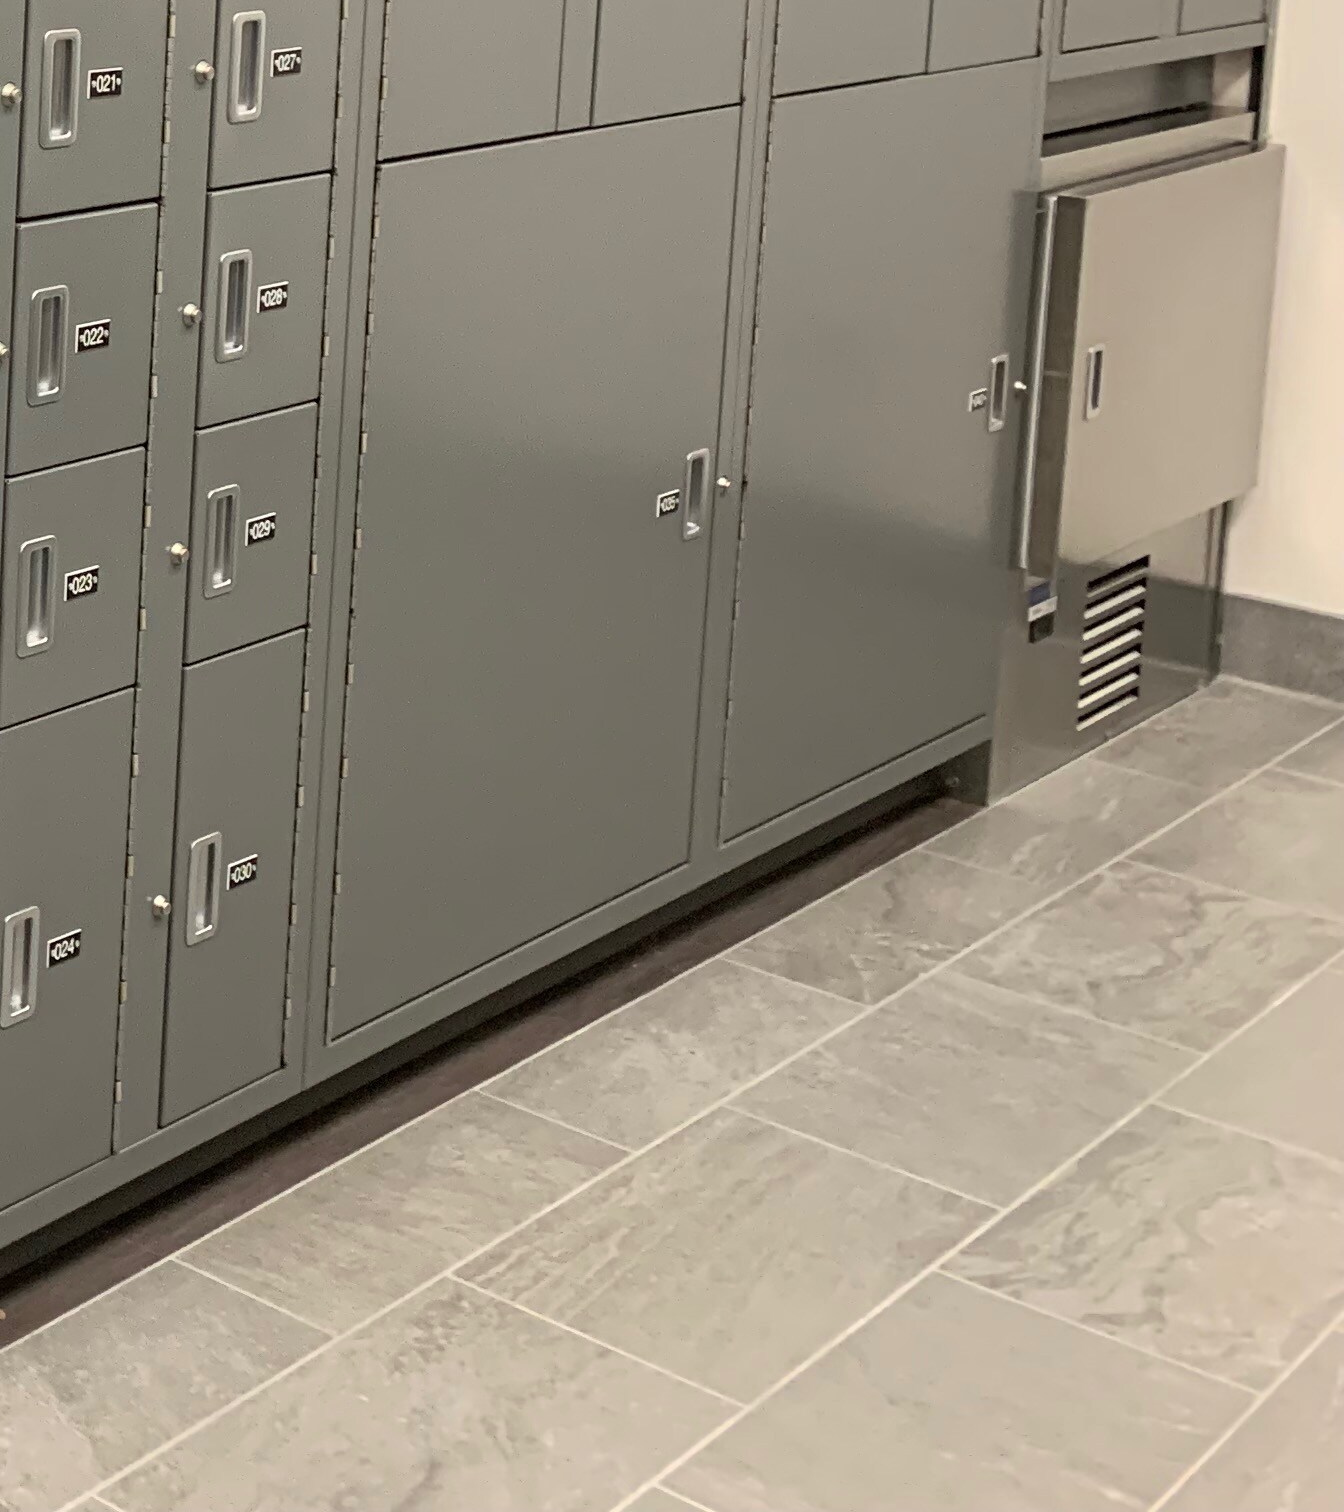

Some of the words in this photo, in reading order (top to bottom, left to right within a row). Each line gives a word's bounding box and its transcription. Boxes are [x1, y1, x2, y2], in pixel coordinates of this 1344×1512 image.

[278, 54, 296, 72] 027
[96, 74, 116, 92] 021
[265, 288, 283, 307] 028
[84, 326, 104, 346] 022
[252, 520, 270, 539] 029
[72, 573, 92, 594] 023
[235, 863, 252, 883] 030
[55, 938, 75, 960] 024
